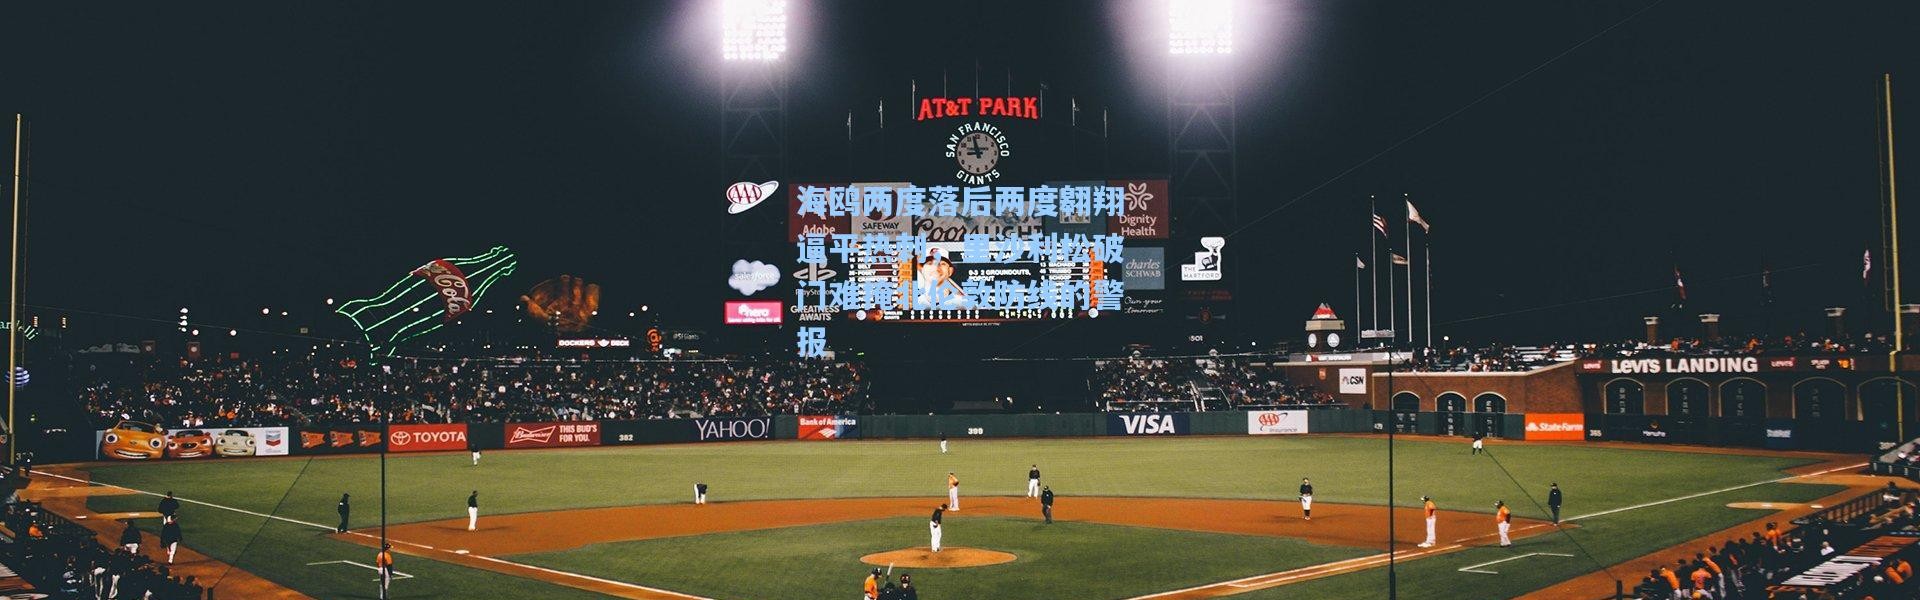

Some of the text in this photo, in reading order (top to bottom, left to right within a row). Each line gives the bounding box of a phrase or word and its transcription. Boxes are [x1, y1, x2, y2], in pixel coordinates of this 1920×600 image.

[917, 96, 1038, 120] AT&T PARK
[946, 121, 1010, 158] SAN FRANCISCO
[956, 169, 1001, 185] GIANTS
[729, 183, 762, 204] AAA
[862, 221, 900, 230] SAFEWAY
[1119, 214, 1157, 226] Dignity
[802, 224, 836, 237] Adobe
[1121, 226, 1156, 236] Health
[1125, 259, 1160, 270] charles
[1125, 270, 1161, 278] SCHWAB
[434, 274, 471, 316] Cola
[799, 312, 832, 321] AWAITS
[1666, 357, 1758, 374] LANDING
[1350, 376, 1365, 385] CSN
[800, 418, 857, 426] Bank of America
[1118, 415, 1176, 434] VISA
[559, 424, 598, 434] THIS BUD'S
[695, 418, 771, 441] YAHOO!
[413, 431, 467, 443] TOYOTA
[559, 433, 591, 442] FOR YOU.
